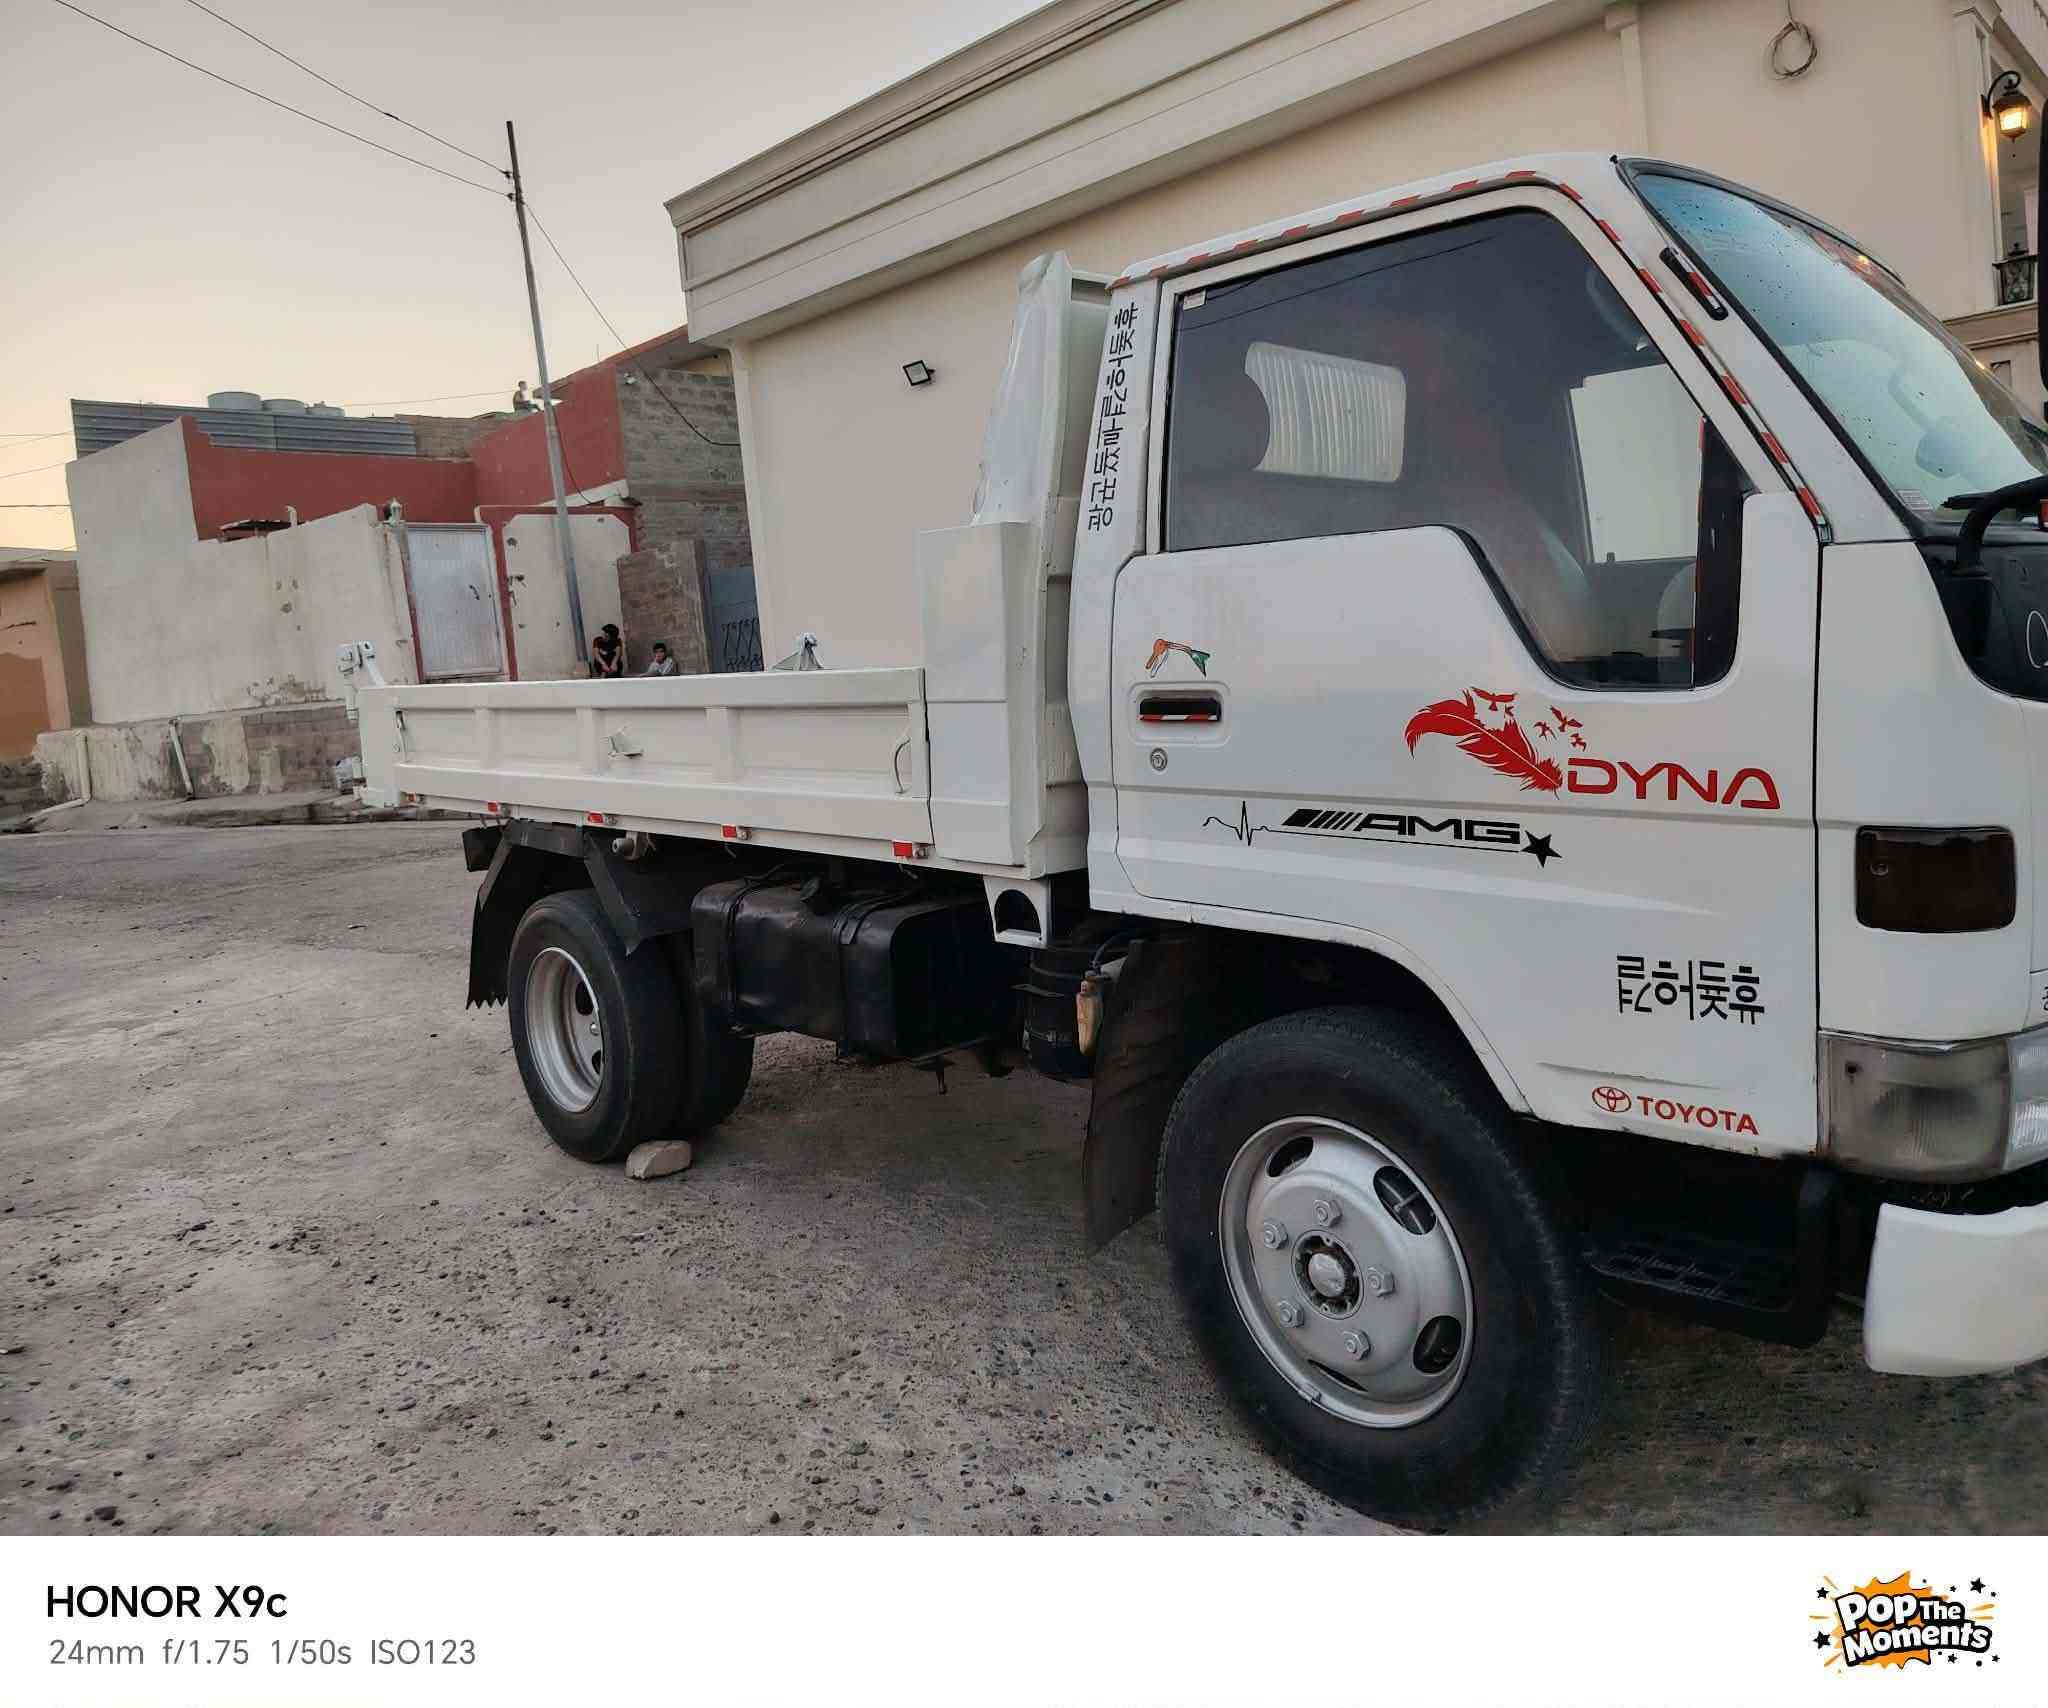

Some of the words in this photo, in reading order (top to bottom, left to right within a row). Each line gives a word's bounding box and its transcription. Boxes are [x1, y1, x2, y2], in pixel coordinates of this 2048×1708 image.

[1567, 757, 1780, 809] DYNA
[1358, 812, 1521, 845] AMG
[1637, 1095, 1759, 1136] TOYOTA
